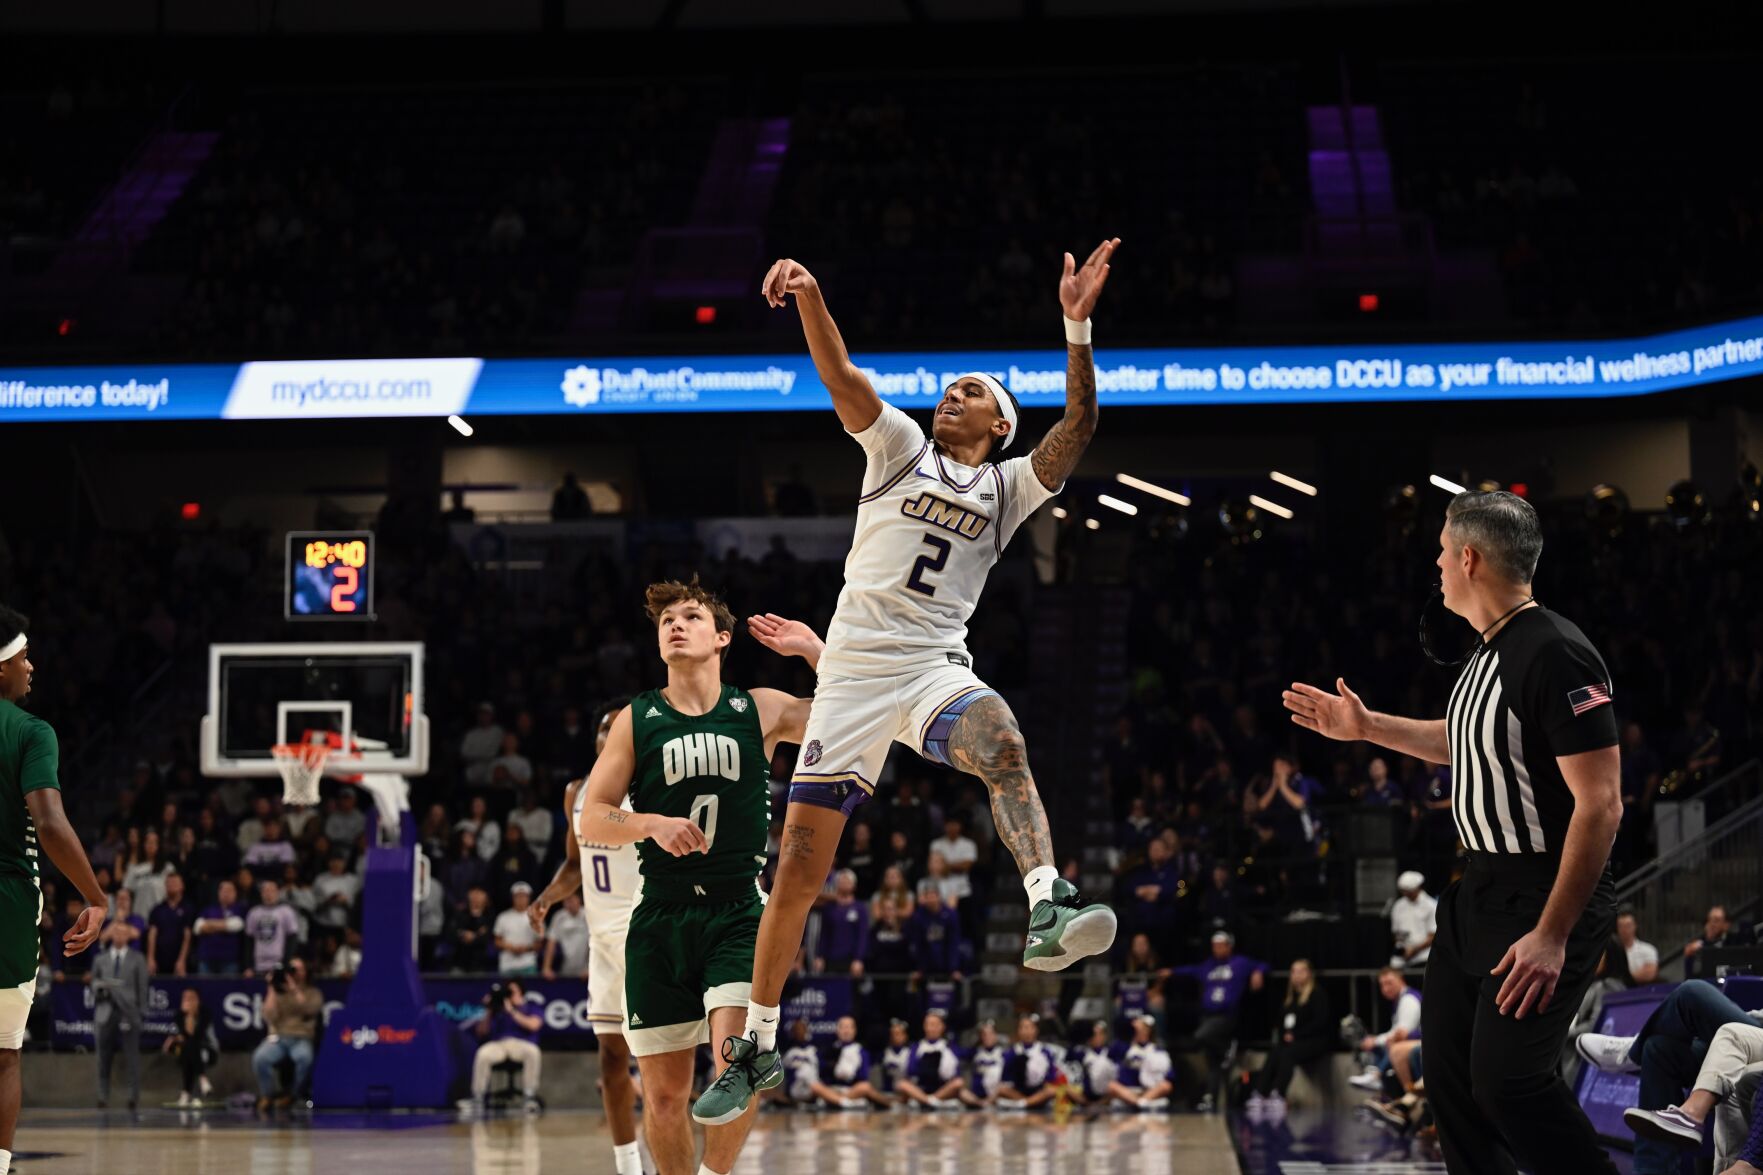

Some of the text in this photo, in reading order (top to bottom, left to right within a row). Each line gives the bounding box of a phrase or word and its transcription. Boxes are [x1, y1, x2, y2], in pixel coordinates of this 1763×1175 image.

[0, 378, 169, 411] ifference today!
[272, 376, 432, 407] mydccu.com
[858, 367, 938, 395] here's
[1009, 365, 1067, 393] been
[1095, 364, 1161, 392] better
[1163, 362, 1217, 391] time
[1220, 363, 1246, 391] to
[1249, 361, 1332, 390] choose
[1336, 358, 1402, 388] DCCU
[1406, 364, 1435, 387] as
[1438, 363, 1492, 392] your
[1496, 355, 1594, 385] financial
[1600, 352, 1691, 383] wellness
[902, 493, 991, 541] JMU
[305, 541, 366, 569] 12:40
[906, 532, 952, 597] 2
[330, 566, 358, 612] 2
[662, 732, 740, 786] OHIO
[689, 794, 719, 852] 0
[592, 855, 611, 893] 0
